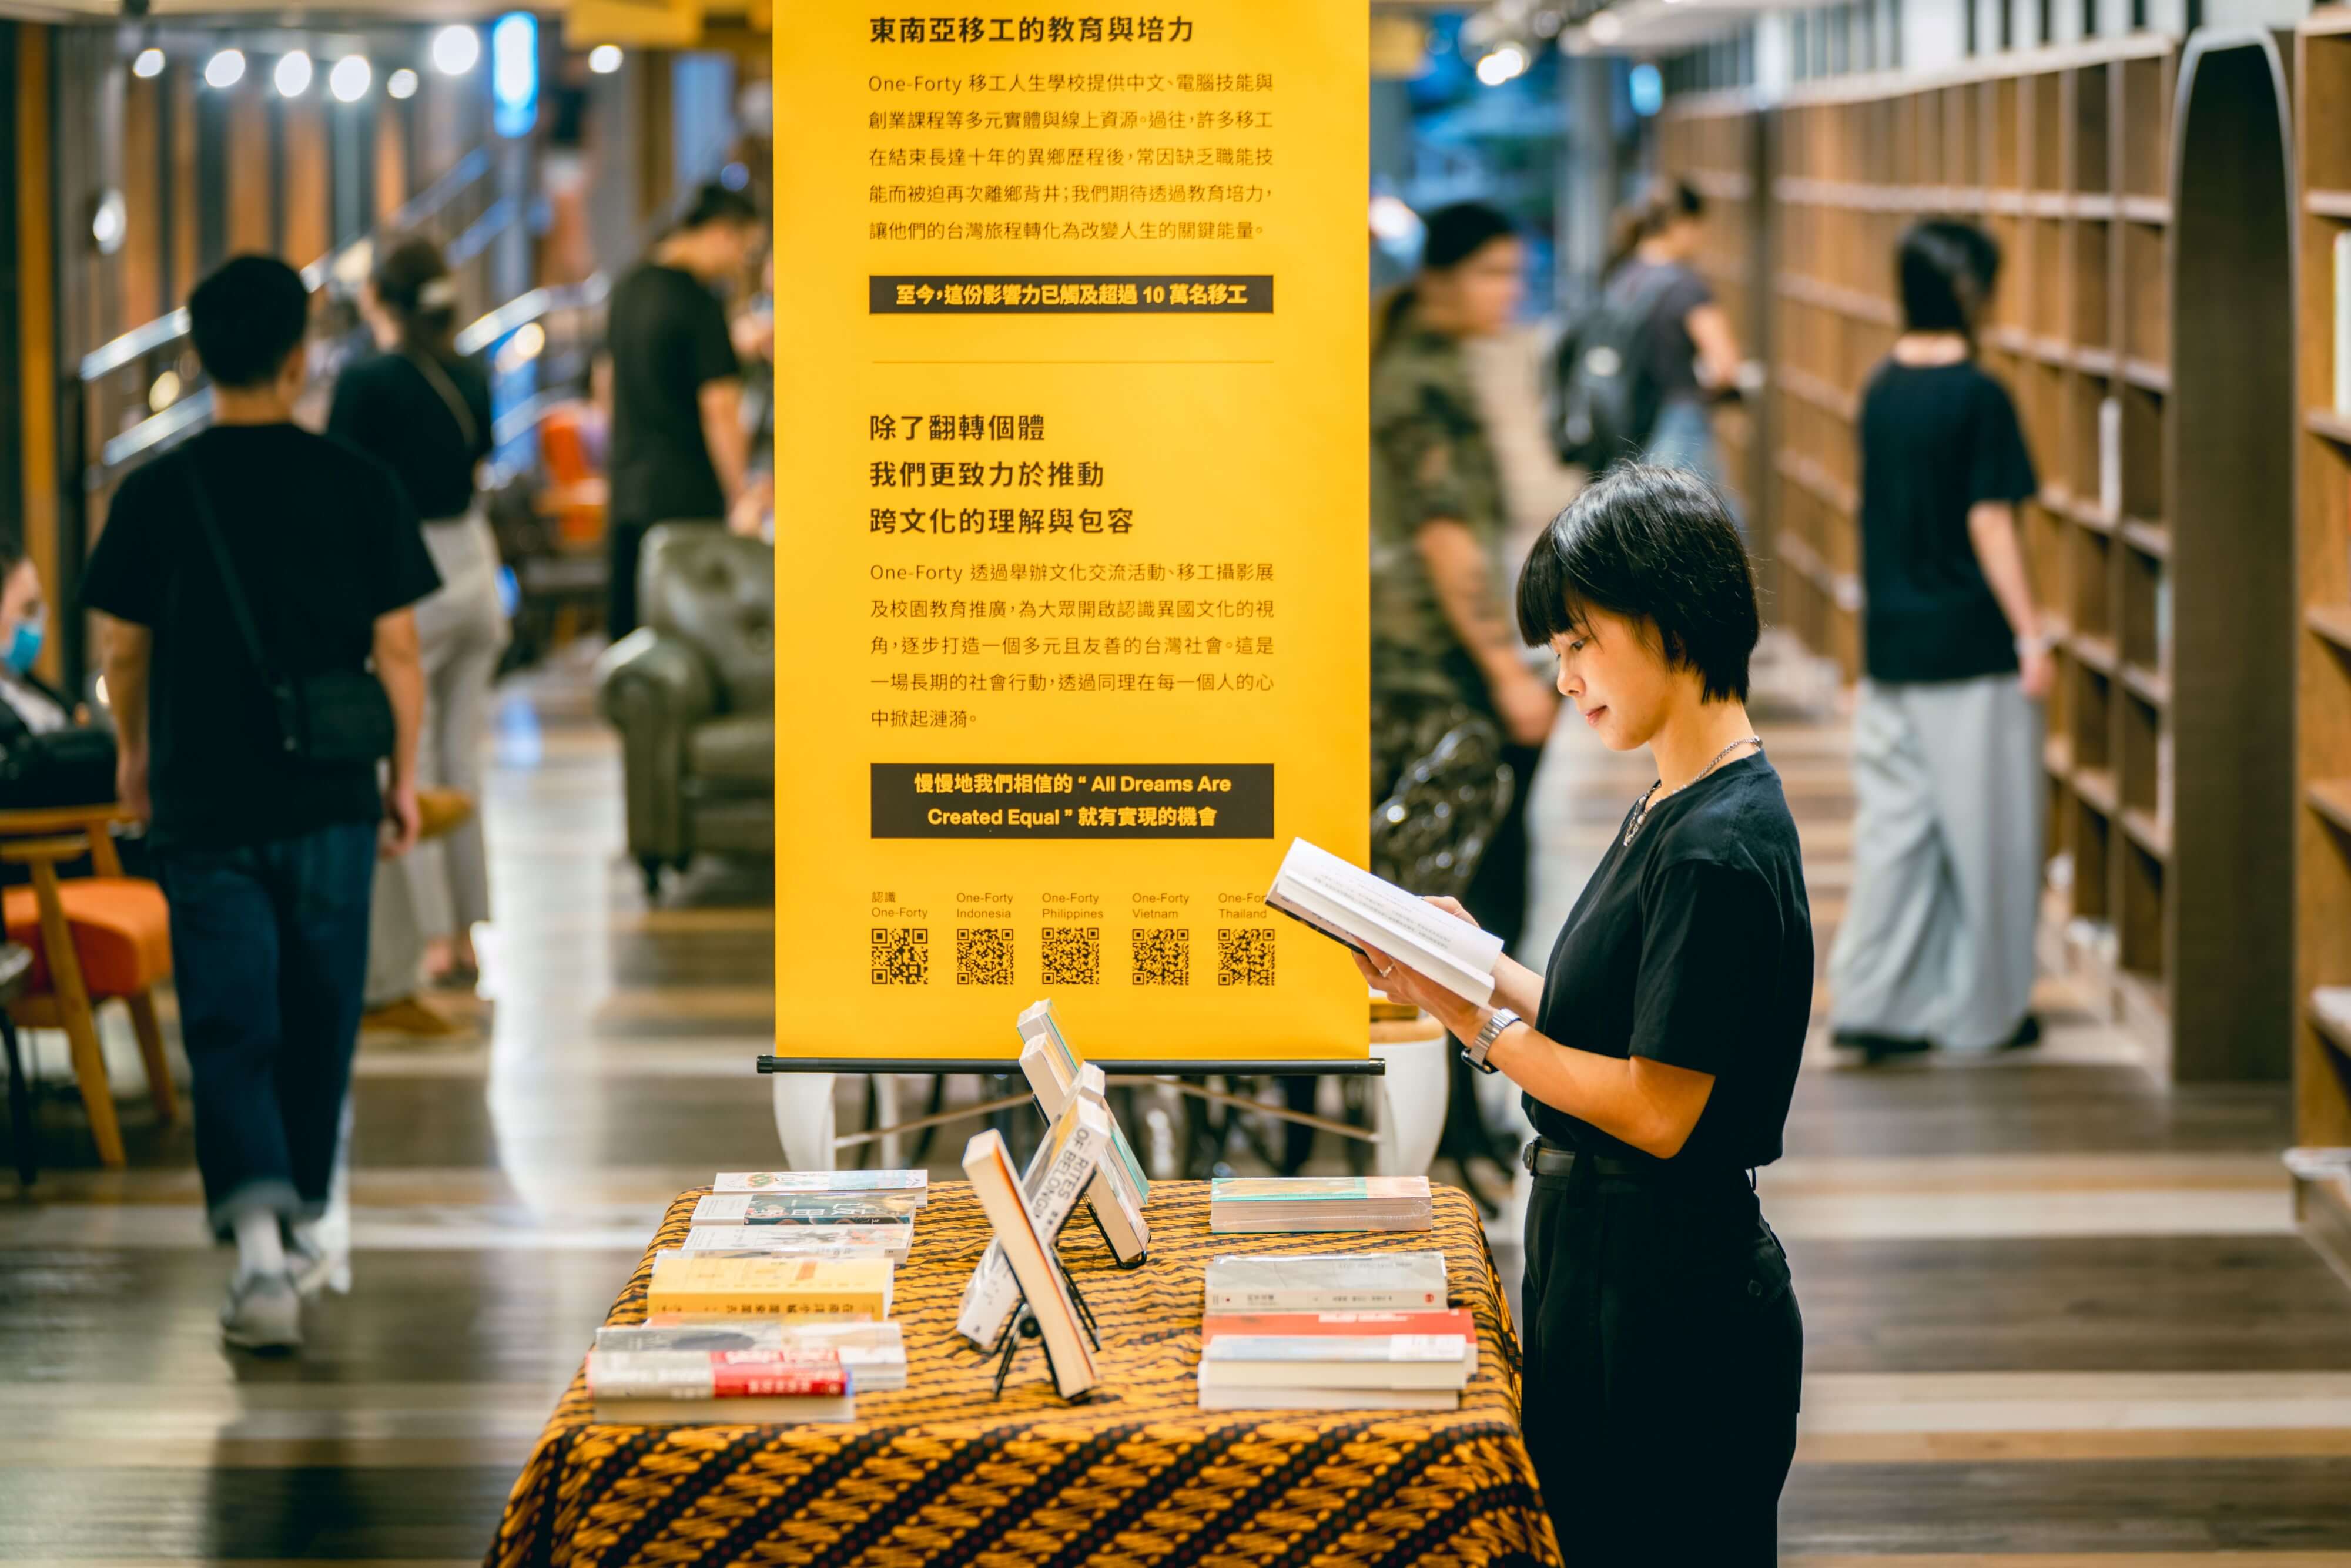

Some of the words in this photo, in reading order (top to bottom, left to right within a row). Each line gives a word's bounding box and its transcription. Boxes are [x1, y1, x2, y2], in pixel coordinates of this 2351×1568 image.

[869, 15, 1193, 44] 東南亞移工的教育與培力
[868, 75, 962, 95] One-Forty
[968, 73, 1273, 92] 移工人生學校提供中文、電腦技能與
[868, 110, 1273, 129] 創業課程等多元實體與線上資源。過往，許多移工
[869, 147, 1273, 166] 在結束長達十年的異鄉歷程後，常因缺乏職能技
[869, 184, 1271, 203] 能而被迫再次離鄉背井；我們期待透過教育培力，
[869, 220, 1263, 240] 讓他們的台灣旅程轉化為改變人生的關鍵能量。
[896, 284, 1138, 305] 至今，這份影響力已觸及超過
[1143, 286, 1165, 304] 10
[1170, 284, 1247, 305] 萬名移工
[870, 413, 1045, 441] 除了翻轉個體
[869, 460, 1104, 488] 我們更致力於推動
[870, 507, 1134, 535] 跨文化的理解與包容
[870, 565, 963, 584] One-Forty
[970, 562, 1274, 582] 透過舉辦文化交流活動、移工攝影展
[870, 599, 1275, 618] 及校園教育推廣，為大眾開啟認識異國文化的視
[870, 636, 1274, 655] 角，逐步打造一個多元且友善的台灣社會。這是
[870, 672, 1274, 692] 一場長期的社會行動，透過同理在每一個人的心
[871, 709, 977, 728] 中掀起漣漪。
[914, 772, 1073, 794] 慢慢地我們相信的
[1090, 775, 1116, 792] All
[1120, 775, 1193, 792] Dreams
[1197, 775, 1232, 792] Are
[927, 808, 1003, 825] Created
[1007, 808, 1060, 829] Equal
[1077, 806, 1218, 827] 就有實現的機會
[871, 891, 896, 903] 認識
[956, 893, 1014, 905] One-Forty
[1041, 893, 1100, 905] One-Forty
[1132, 893, 1190, 905] One-Forty
[1218, 893, 1266, 903] One-For
[871, 907, 928, 919] One-Forty
[956, 908, 1012, 919] Indonesia
[1041, 908, 1104, 921] Philippines
[1131, 908, 1179, 919] Vietnam
[1218, 908, 1267, 919] Thailand
[1074, 1128, 1090, 1150] OF
[1058, 1155, 1089, 1200] RITES
